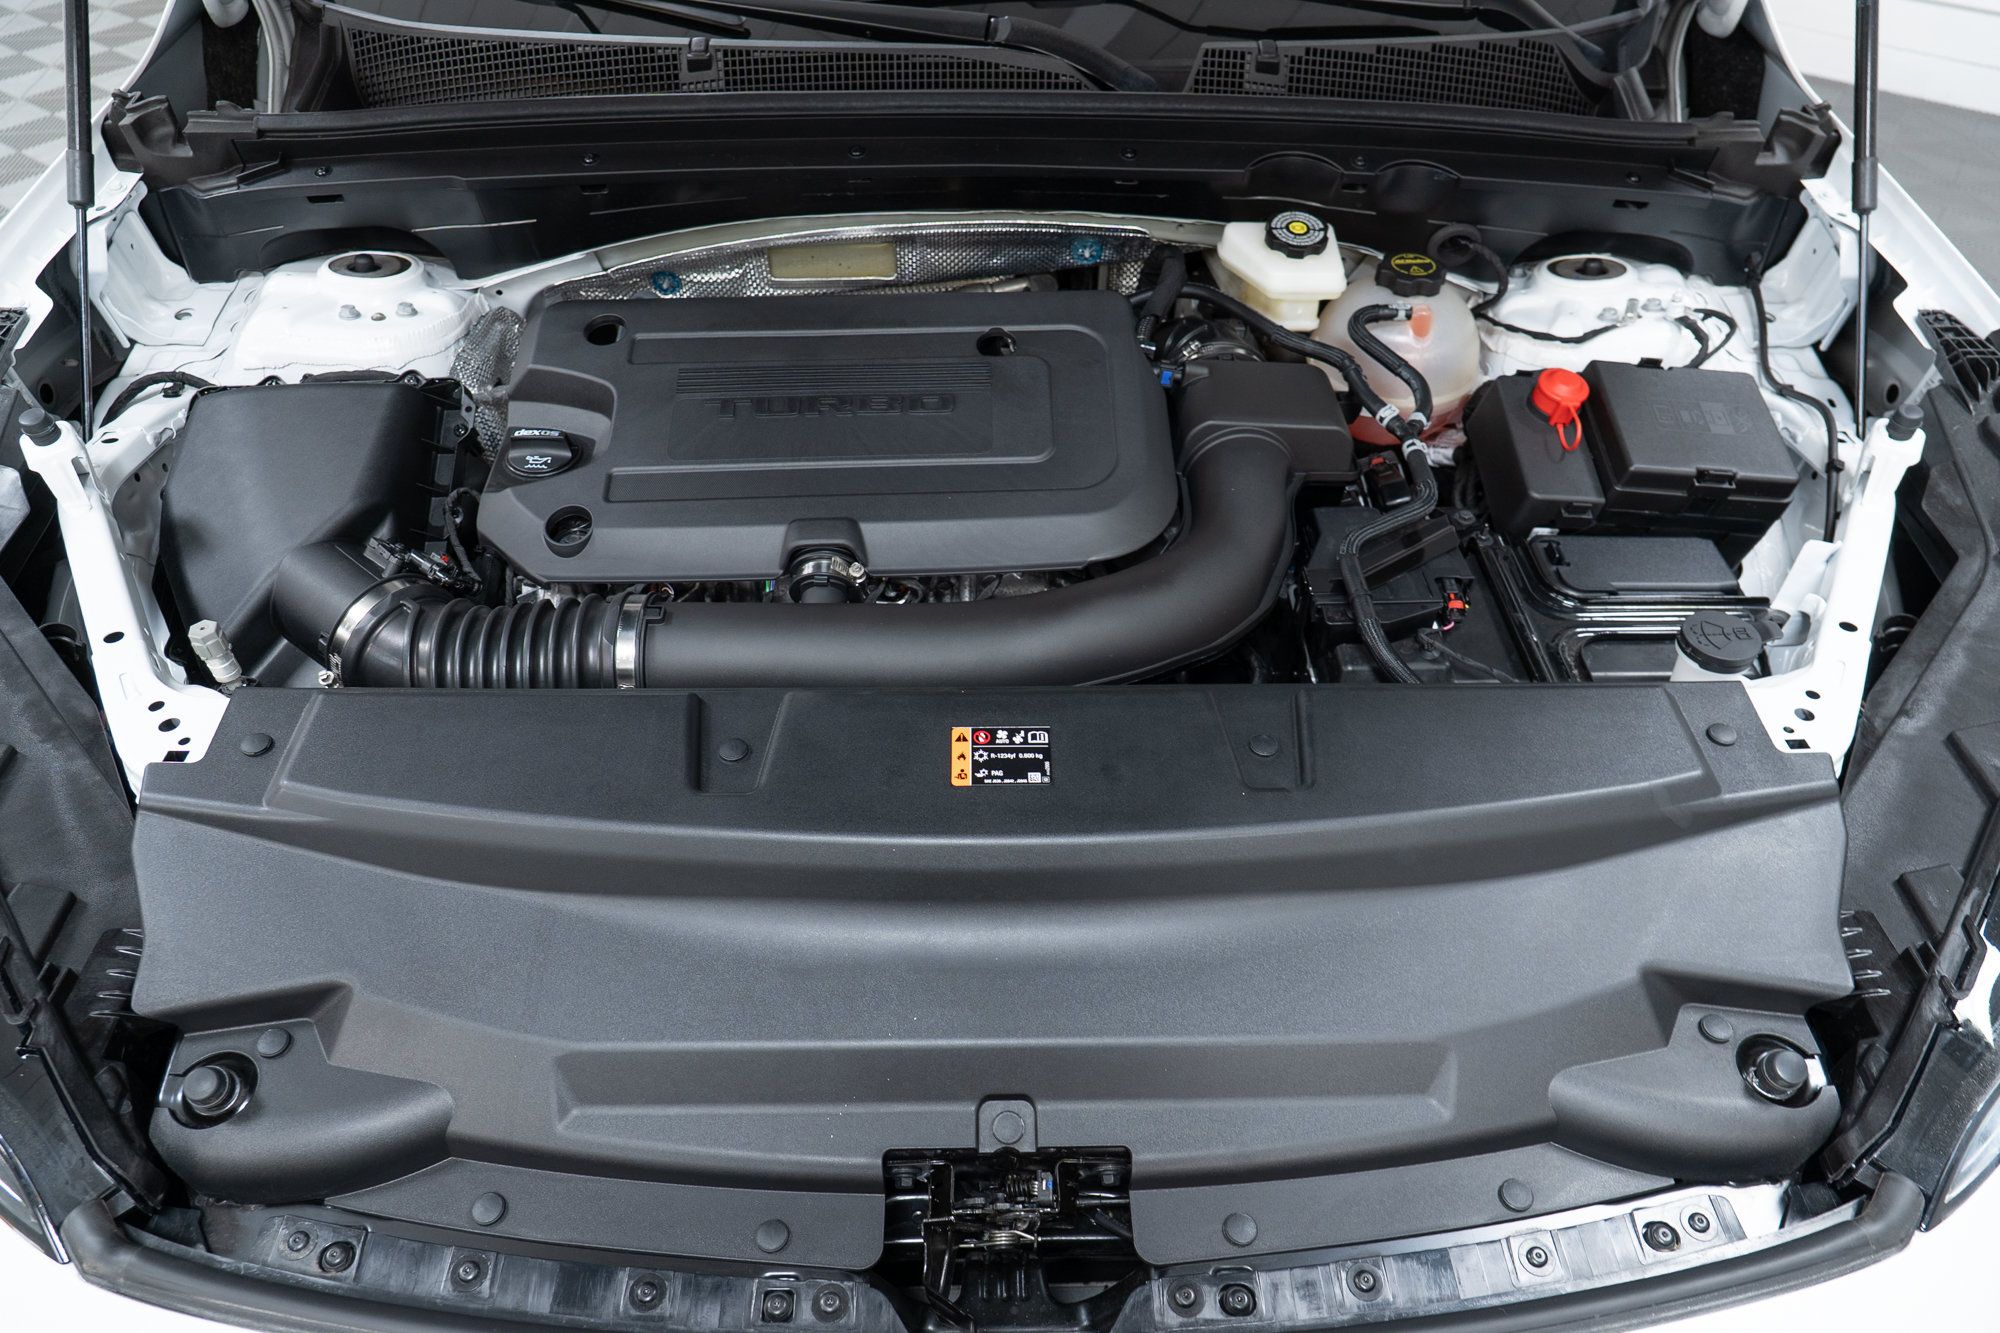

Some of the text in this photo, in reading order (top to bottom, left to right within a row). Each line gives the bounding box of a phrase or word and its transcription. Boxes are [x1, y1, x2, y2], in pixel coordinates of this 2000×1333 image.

[703, 394, 956, 419] TURBO
[514, 428, 561, 437] dexos
[991, 769, 1004, 777] PAG
